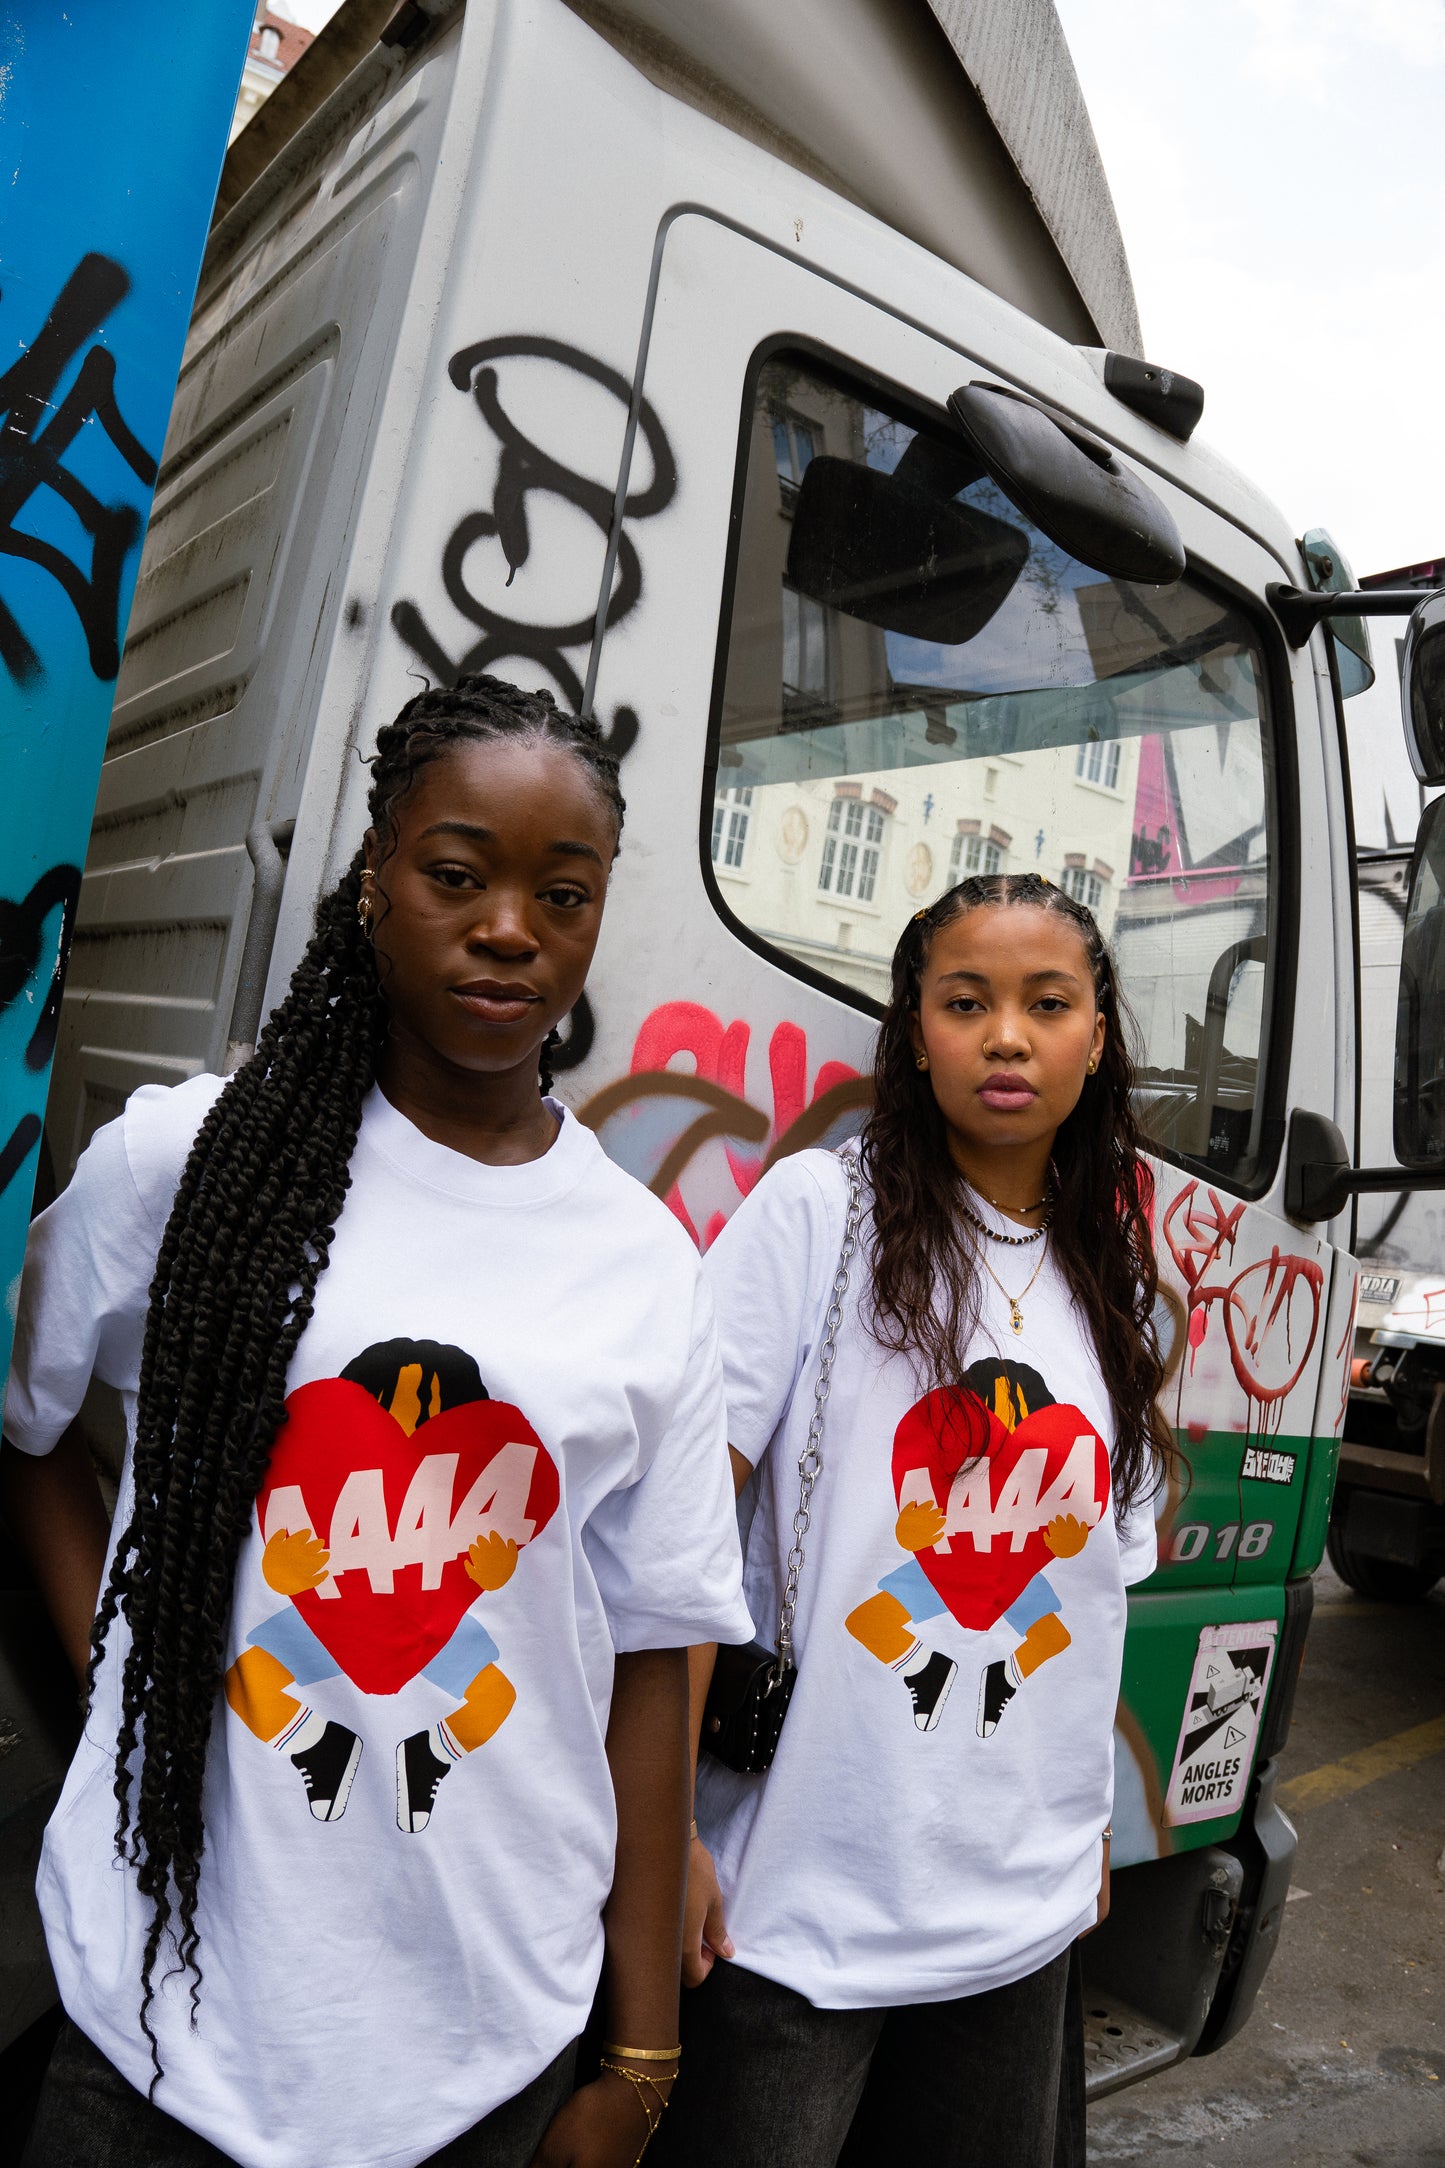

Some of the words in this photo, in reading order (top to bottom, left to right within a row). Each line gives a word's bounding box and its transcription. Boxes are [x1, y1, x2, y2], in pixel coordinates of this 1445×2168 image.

[1169, 1521, 1275, 1564] 018
[1182, 1757, 1241, 1785] ANGLES
[1181, 1779, 1234, 1806] MORTS
